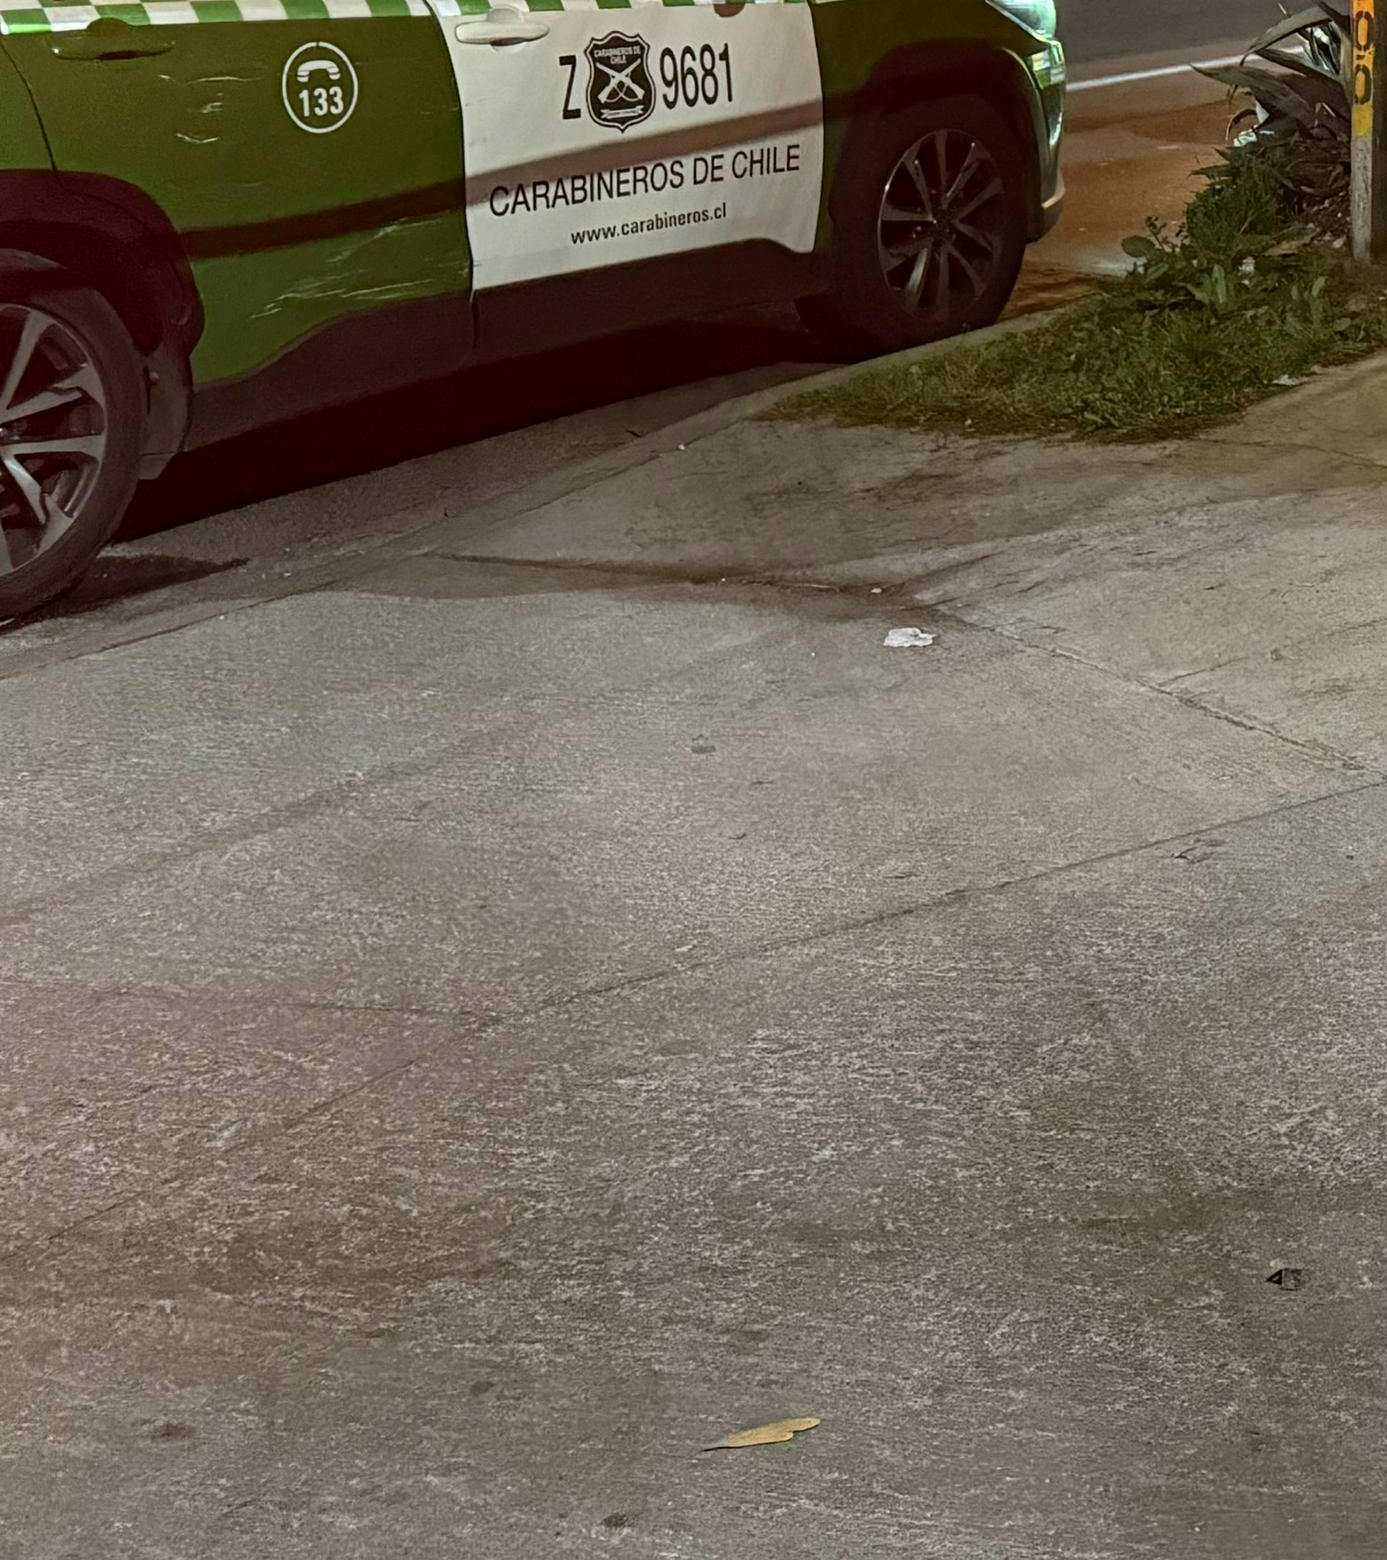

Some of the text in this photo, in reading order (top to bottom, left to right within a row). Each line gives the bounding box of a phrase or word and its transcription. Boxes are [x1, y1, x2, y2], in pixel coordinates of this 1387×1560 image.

[299, 86, 344, 117] 133
[558, 42, 733, 120] Z 9681
[489, 144, 800, 217] CARABINEROS DE CHILE
[570, 202, 727, 244] www.carabineros.cl
